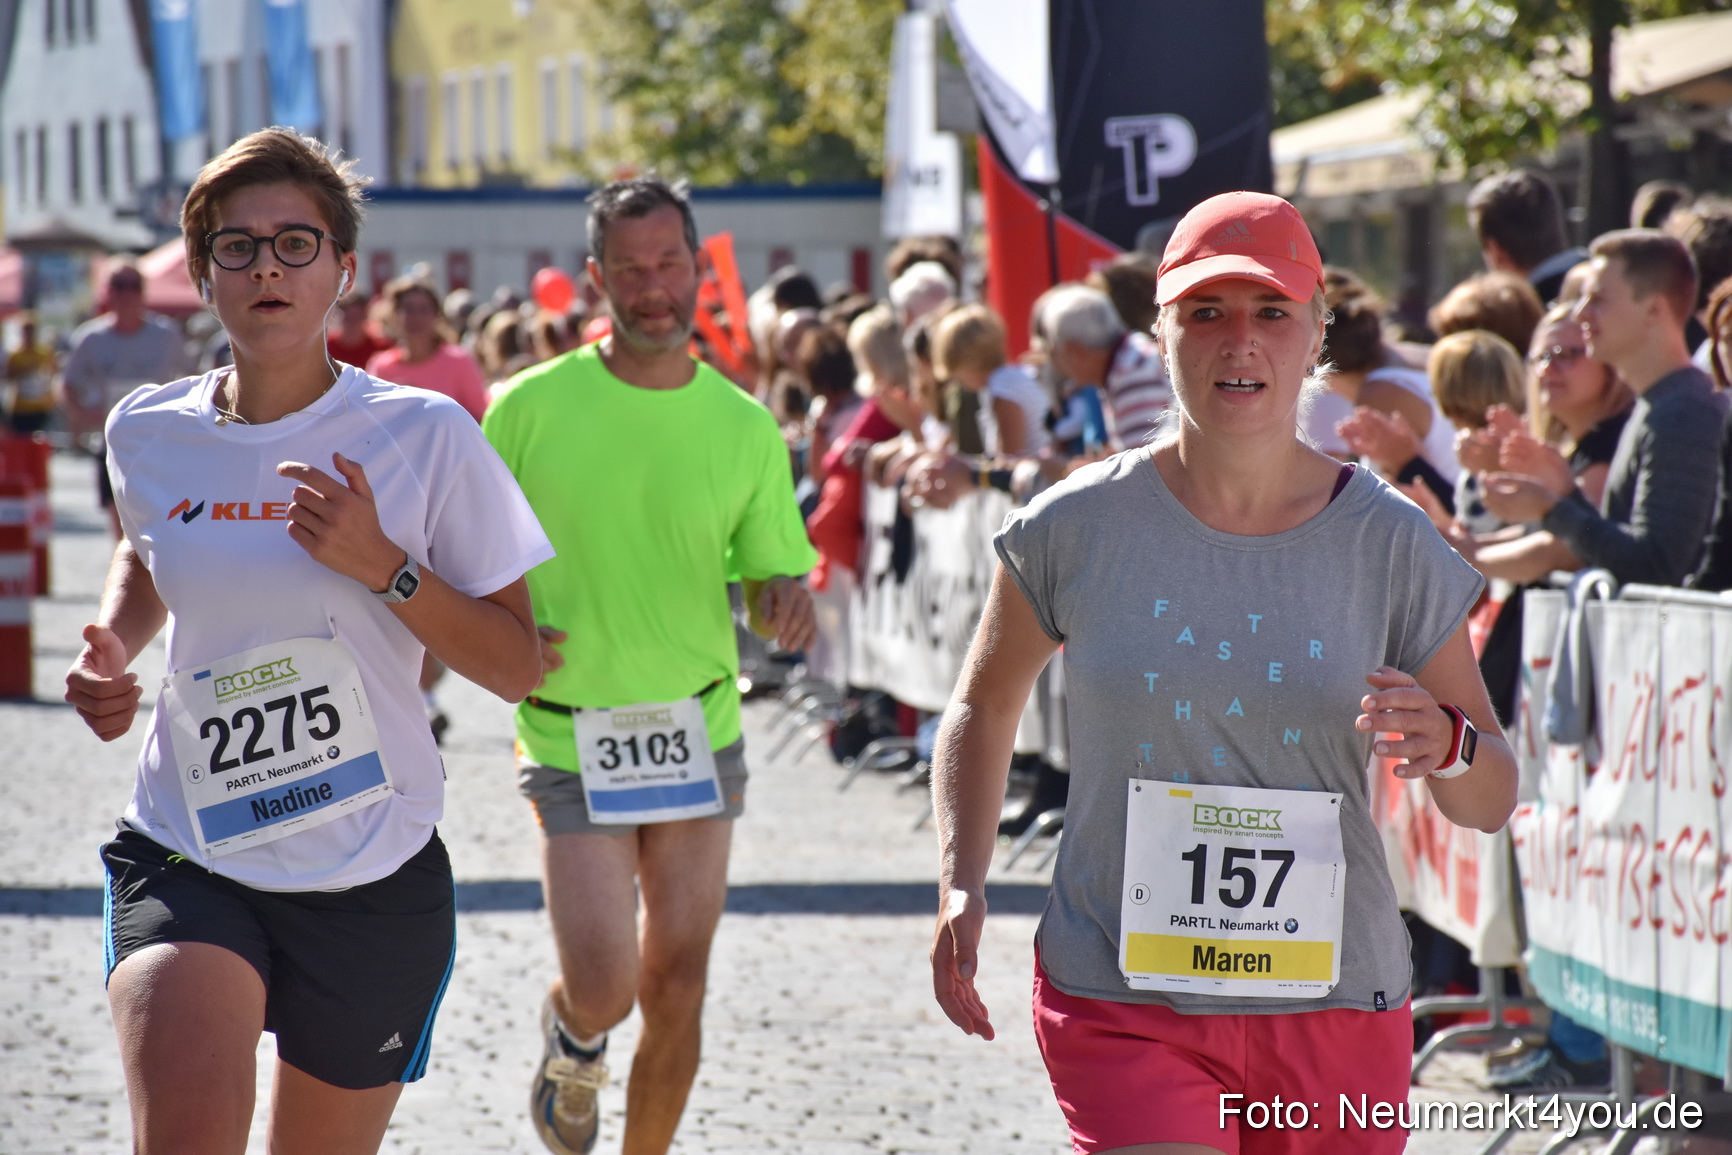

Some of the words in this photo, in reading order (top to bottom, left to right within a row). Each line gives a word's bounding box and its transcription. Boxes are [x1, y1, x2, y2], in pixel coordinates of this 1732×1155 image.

[1212, 235, 1257, 246] adidas
[214, 657, 299, 698] BOCK
[217, 692, 243, 705] inspired
[243, 690, 252, 699] by
[253, 685, 271, 695] smart
[272, 676, 301, 691] concepts
[200, 685, 341, 775] 2275
[596, 730, 690, 771] 3103
[226, 772, 266, 792] PARTL
[267, 754, 324, 779] Neumarkt
[250, 782, 333, 822] Nadine
[1193, 826, 1222, 836] inspired
[1224, 829, 1233, 837] by
[1235, 830, 1254, 838] smart
[1194, 804, 1282, 831] BOCK
[1182, 844, 1295, 908] 157
[1170, 915, 1216, 929] PARTL
[1219, 918, 1279, 931] Neumarkt
[1193, 945, 1271, 973] Maren
[379, 1041, 403, 1053] adidas
